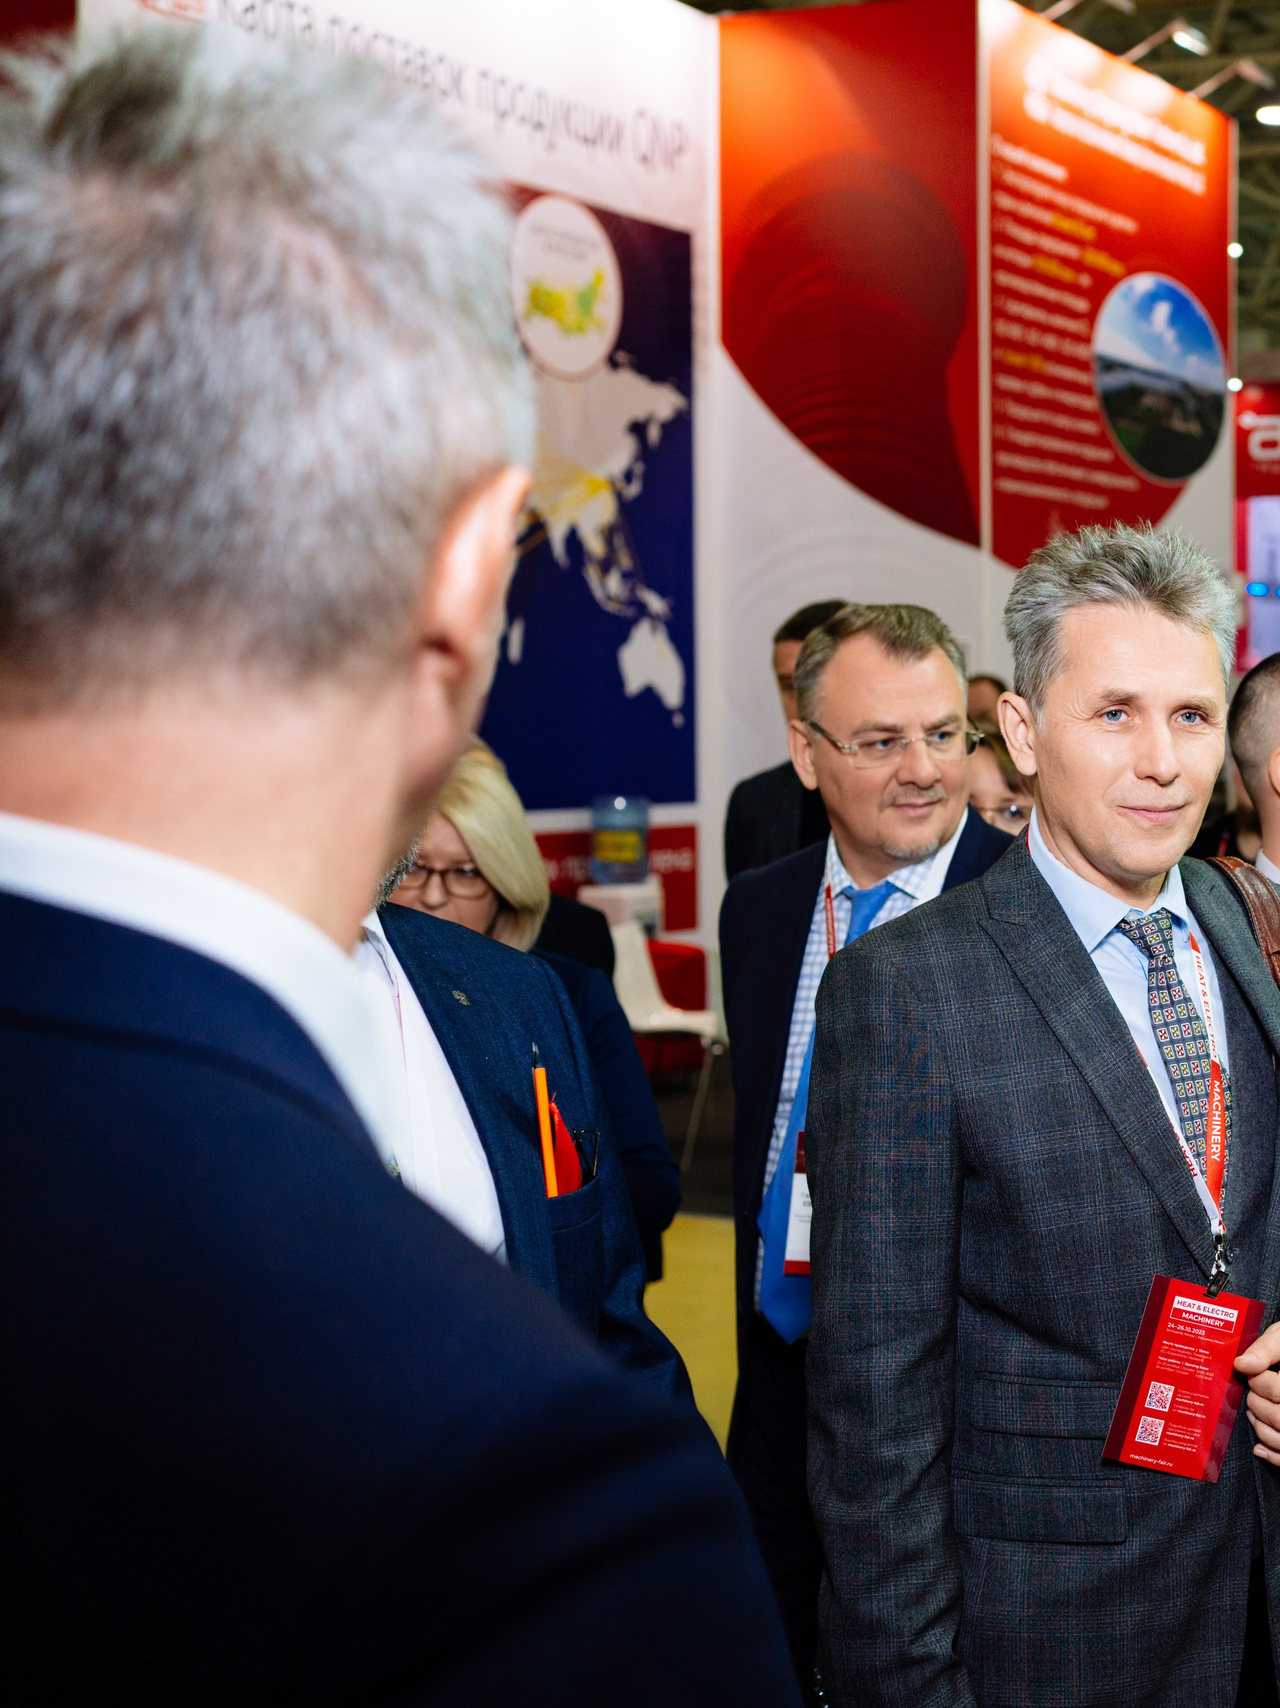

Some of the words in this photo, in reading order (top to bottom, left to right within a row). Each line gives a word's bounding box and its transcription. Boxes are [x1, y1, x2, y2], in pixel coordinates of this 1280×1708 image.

[1195, 955, 1207, 988] HEAT
[1202, 989, 1208, 998] &
[1204, 1000, 1217, 1059] ELECTRO
[1210, 1080, 1222, 1162] MACHINERY
[1177, 1300, 1196, 1309] HEAT
[1203, 1306, 1234, 1318] ELECTRO
[1182, 1312, 1224, 1327] MACHINERY
[1130, 1453, 1173, 1466] machinery-fair.ru
